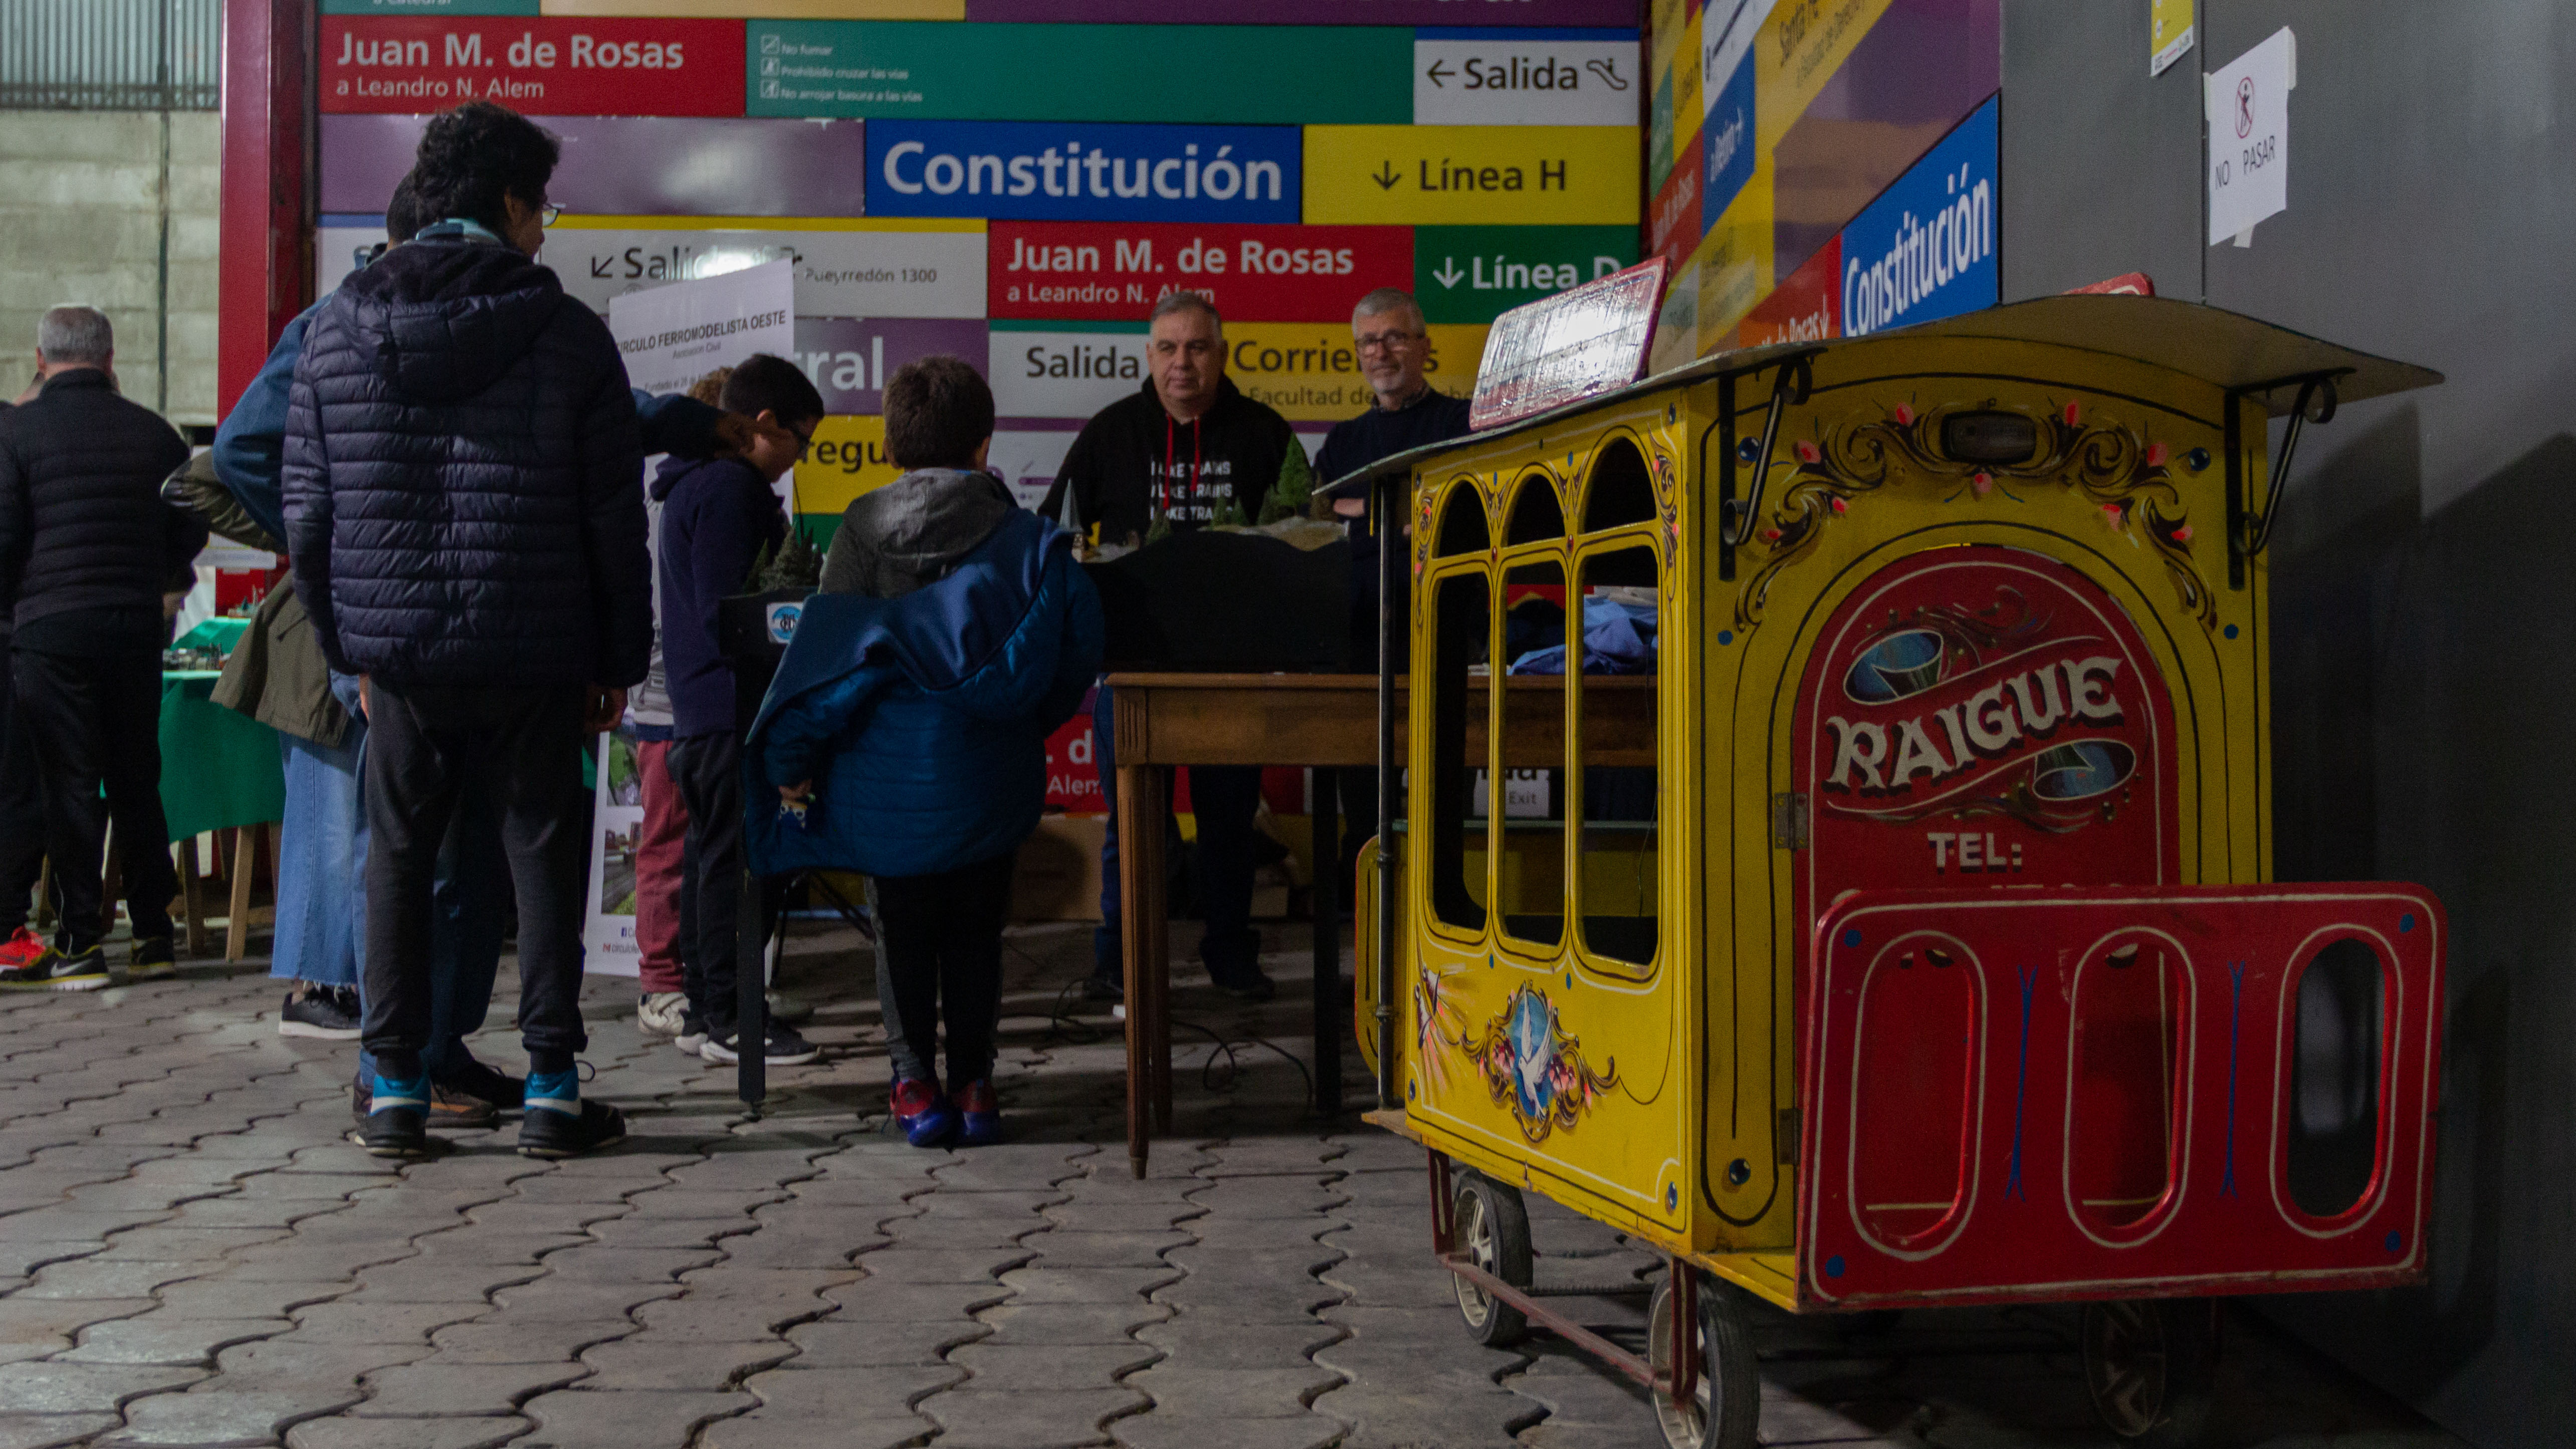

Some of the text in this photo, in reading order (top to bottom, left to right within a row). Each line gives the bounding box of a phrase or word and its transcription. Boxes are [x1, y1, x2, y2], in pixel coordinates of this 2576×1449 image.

[338, 32, 684, 69] Juan M. de Rosas
[337, 76, 545, 98] a Leandro N. Alem
[1464, 56, 1579, 90] Salida
[884, 140, 1282, 201] Constitución
[1419, 157, 1567, 192] Línea H
[2215, 134, 2276, 190] NO PASAR
[1008, 238, 1355, 275] Juan M. de Rosas
[1844, 161, 1991, 339] Constitución
[805, 266, 895, 285] Pueyrredón
[900, 268, 937, 284] 1300
[1472, 256, 1580, 290] Línea
[1007, 287, 1020, 302] a
[1027, 283, 1119, 303] Leandro
[1126, 283, 1150, 303] N.
[658, 318, 748, 348] FERROMODELISTA
[750, 310, 786, 329] OESTE
[1026, 345, 1140, 379] Salida
[1249, 386, 1375, 405] Facultad de
[1158, 461, 1185, 478] LKE
[1158, 483, 1186, 499] LKE
[1823, 656, 2124, 793] RAIGUE
[1509, 790, 1537, 805] Exit
[1927, 832, 2023, 872] TEL:
